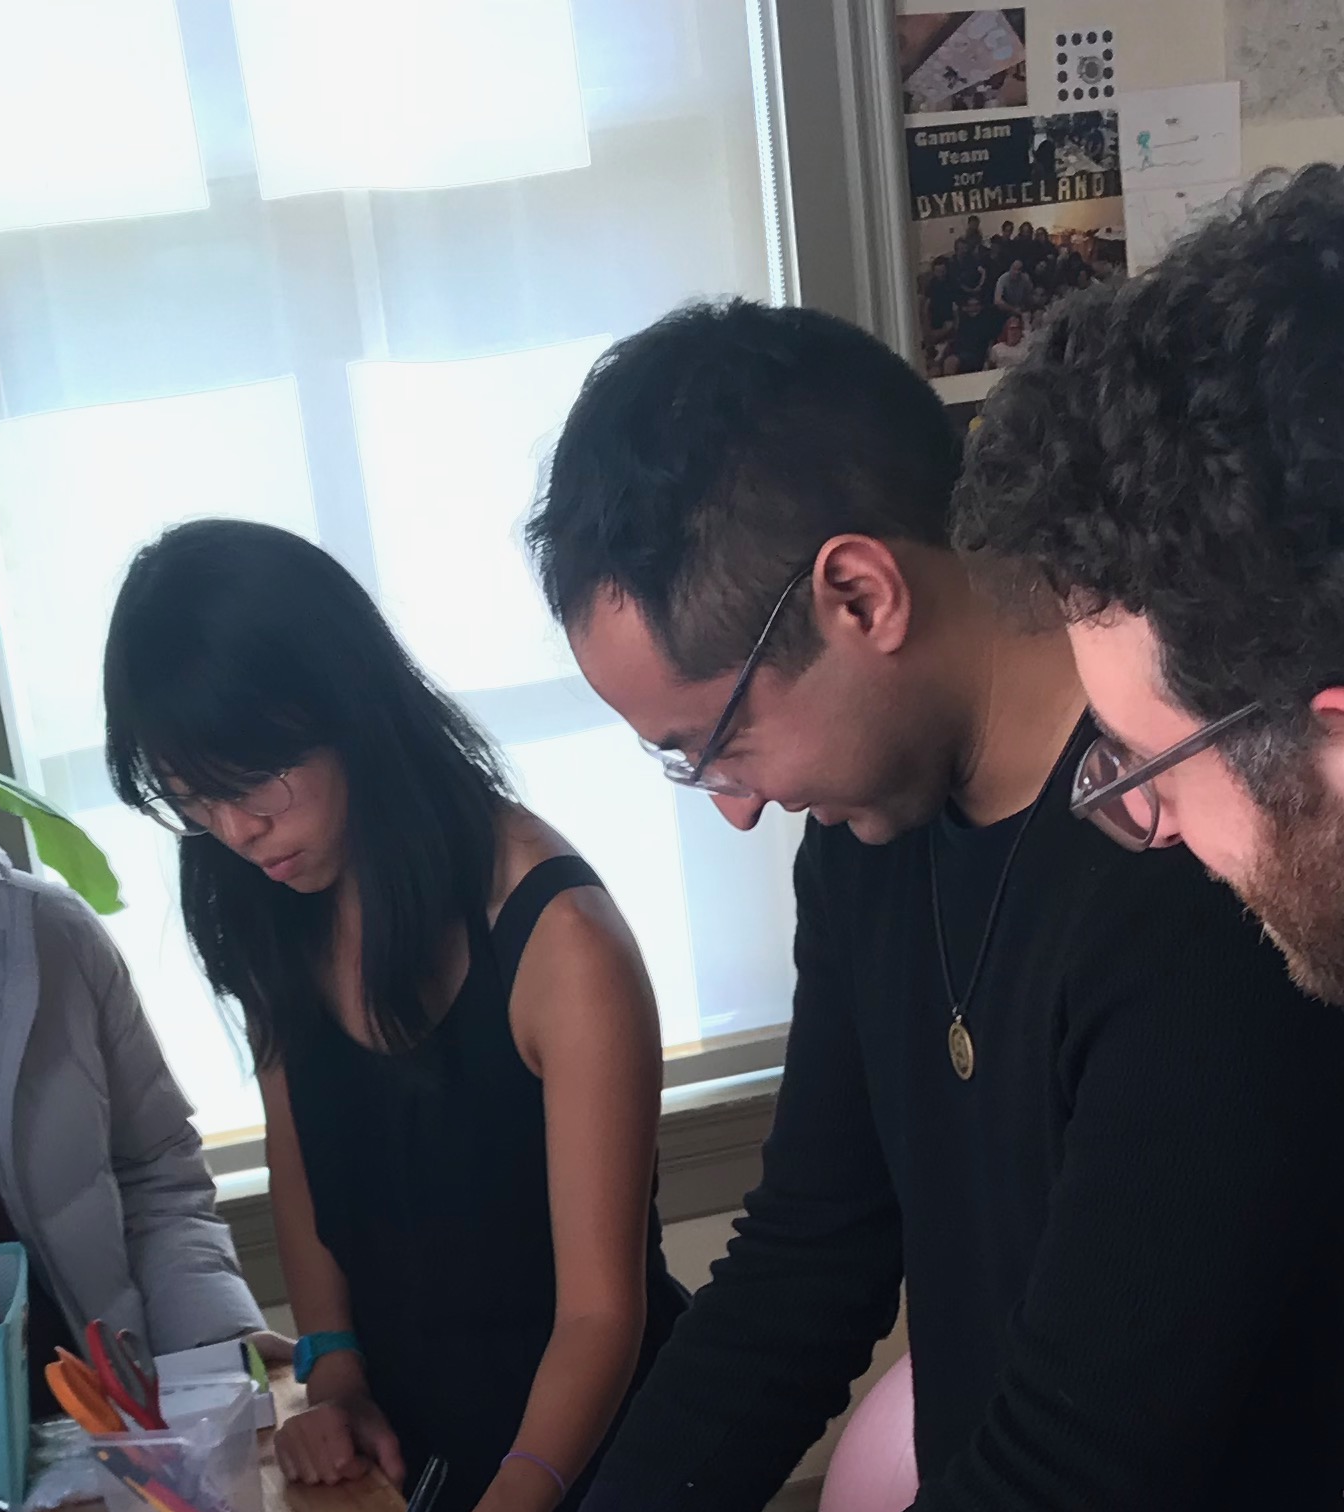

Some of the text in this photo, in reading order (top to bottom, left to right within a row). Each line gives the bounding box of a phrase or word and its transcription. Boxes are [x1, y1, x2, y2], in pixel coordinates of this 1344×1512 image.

[914, 124, 1011, 147] Game Jam
[937, 148, 990, 166] Team
[952, 170, 984, 187] 2017
[916, 172, 1106, 219] DYNAMICLAND
